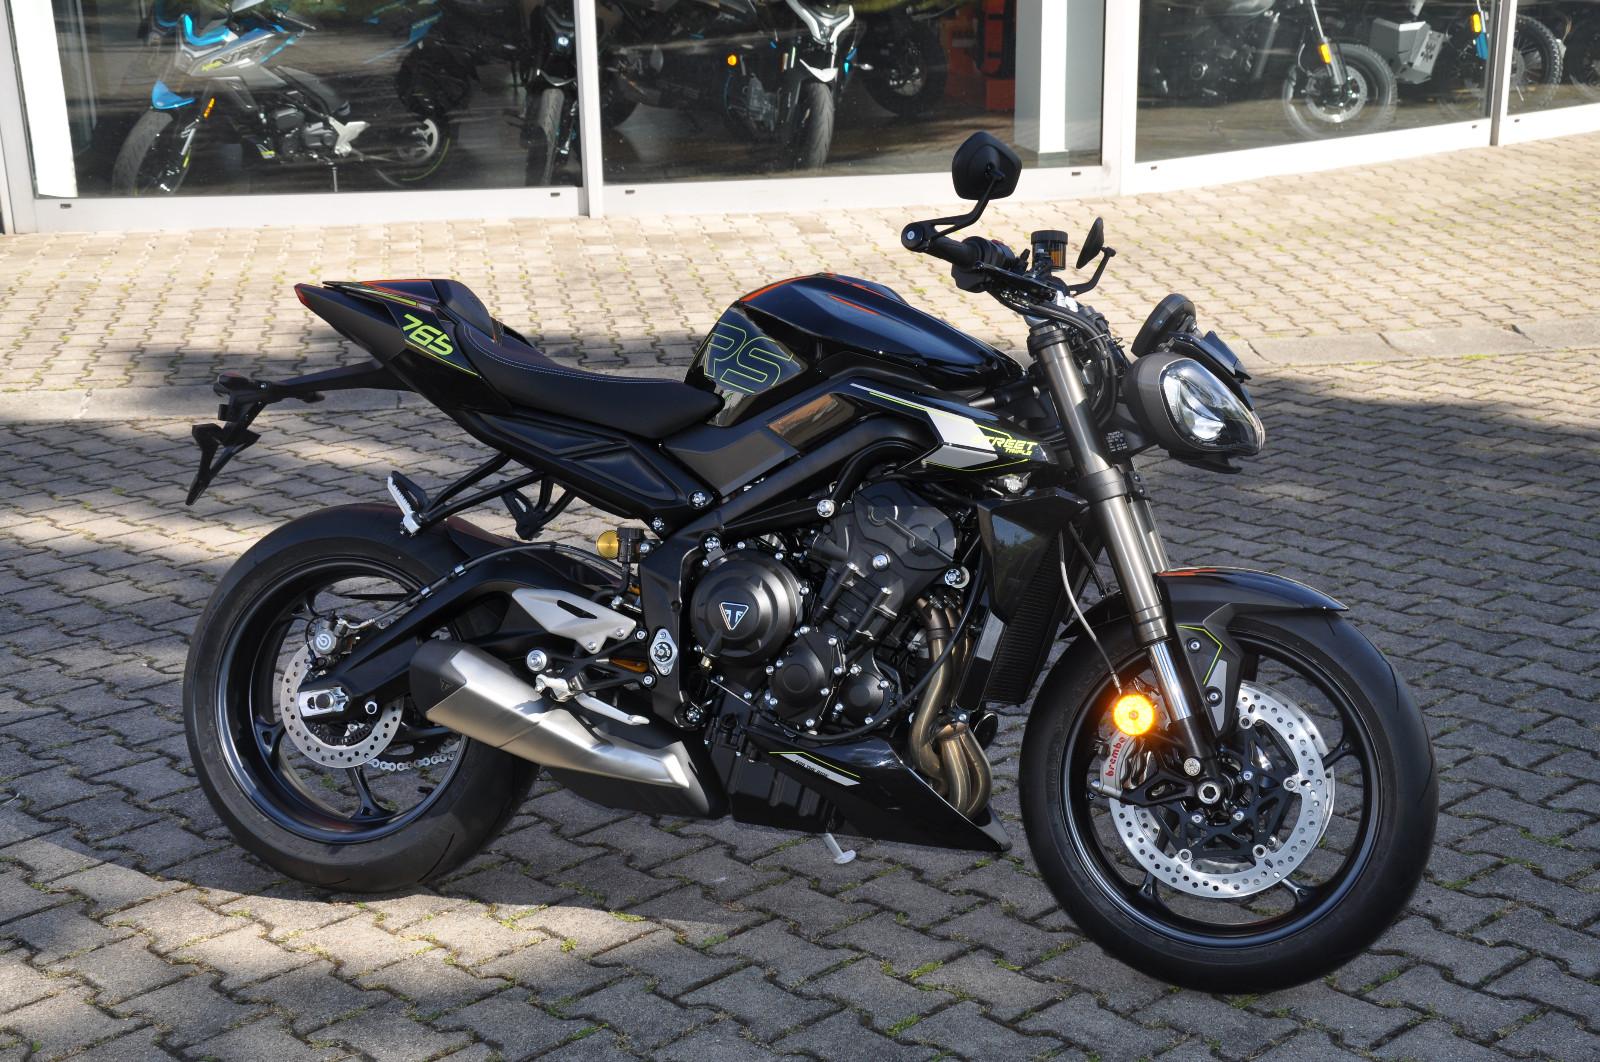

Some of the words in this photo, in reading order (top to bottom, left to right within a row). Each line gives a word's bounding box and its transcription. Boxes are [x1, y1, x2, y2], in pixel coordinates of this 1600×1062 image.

[402, 313, 454, 356] 765
[700, 321, 794, 393] RS
[1105, 736, 1125, 777] brembo
